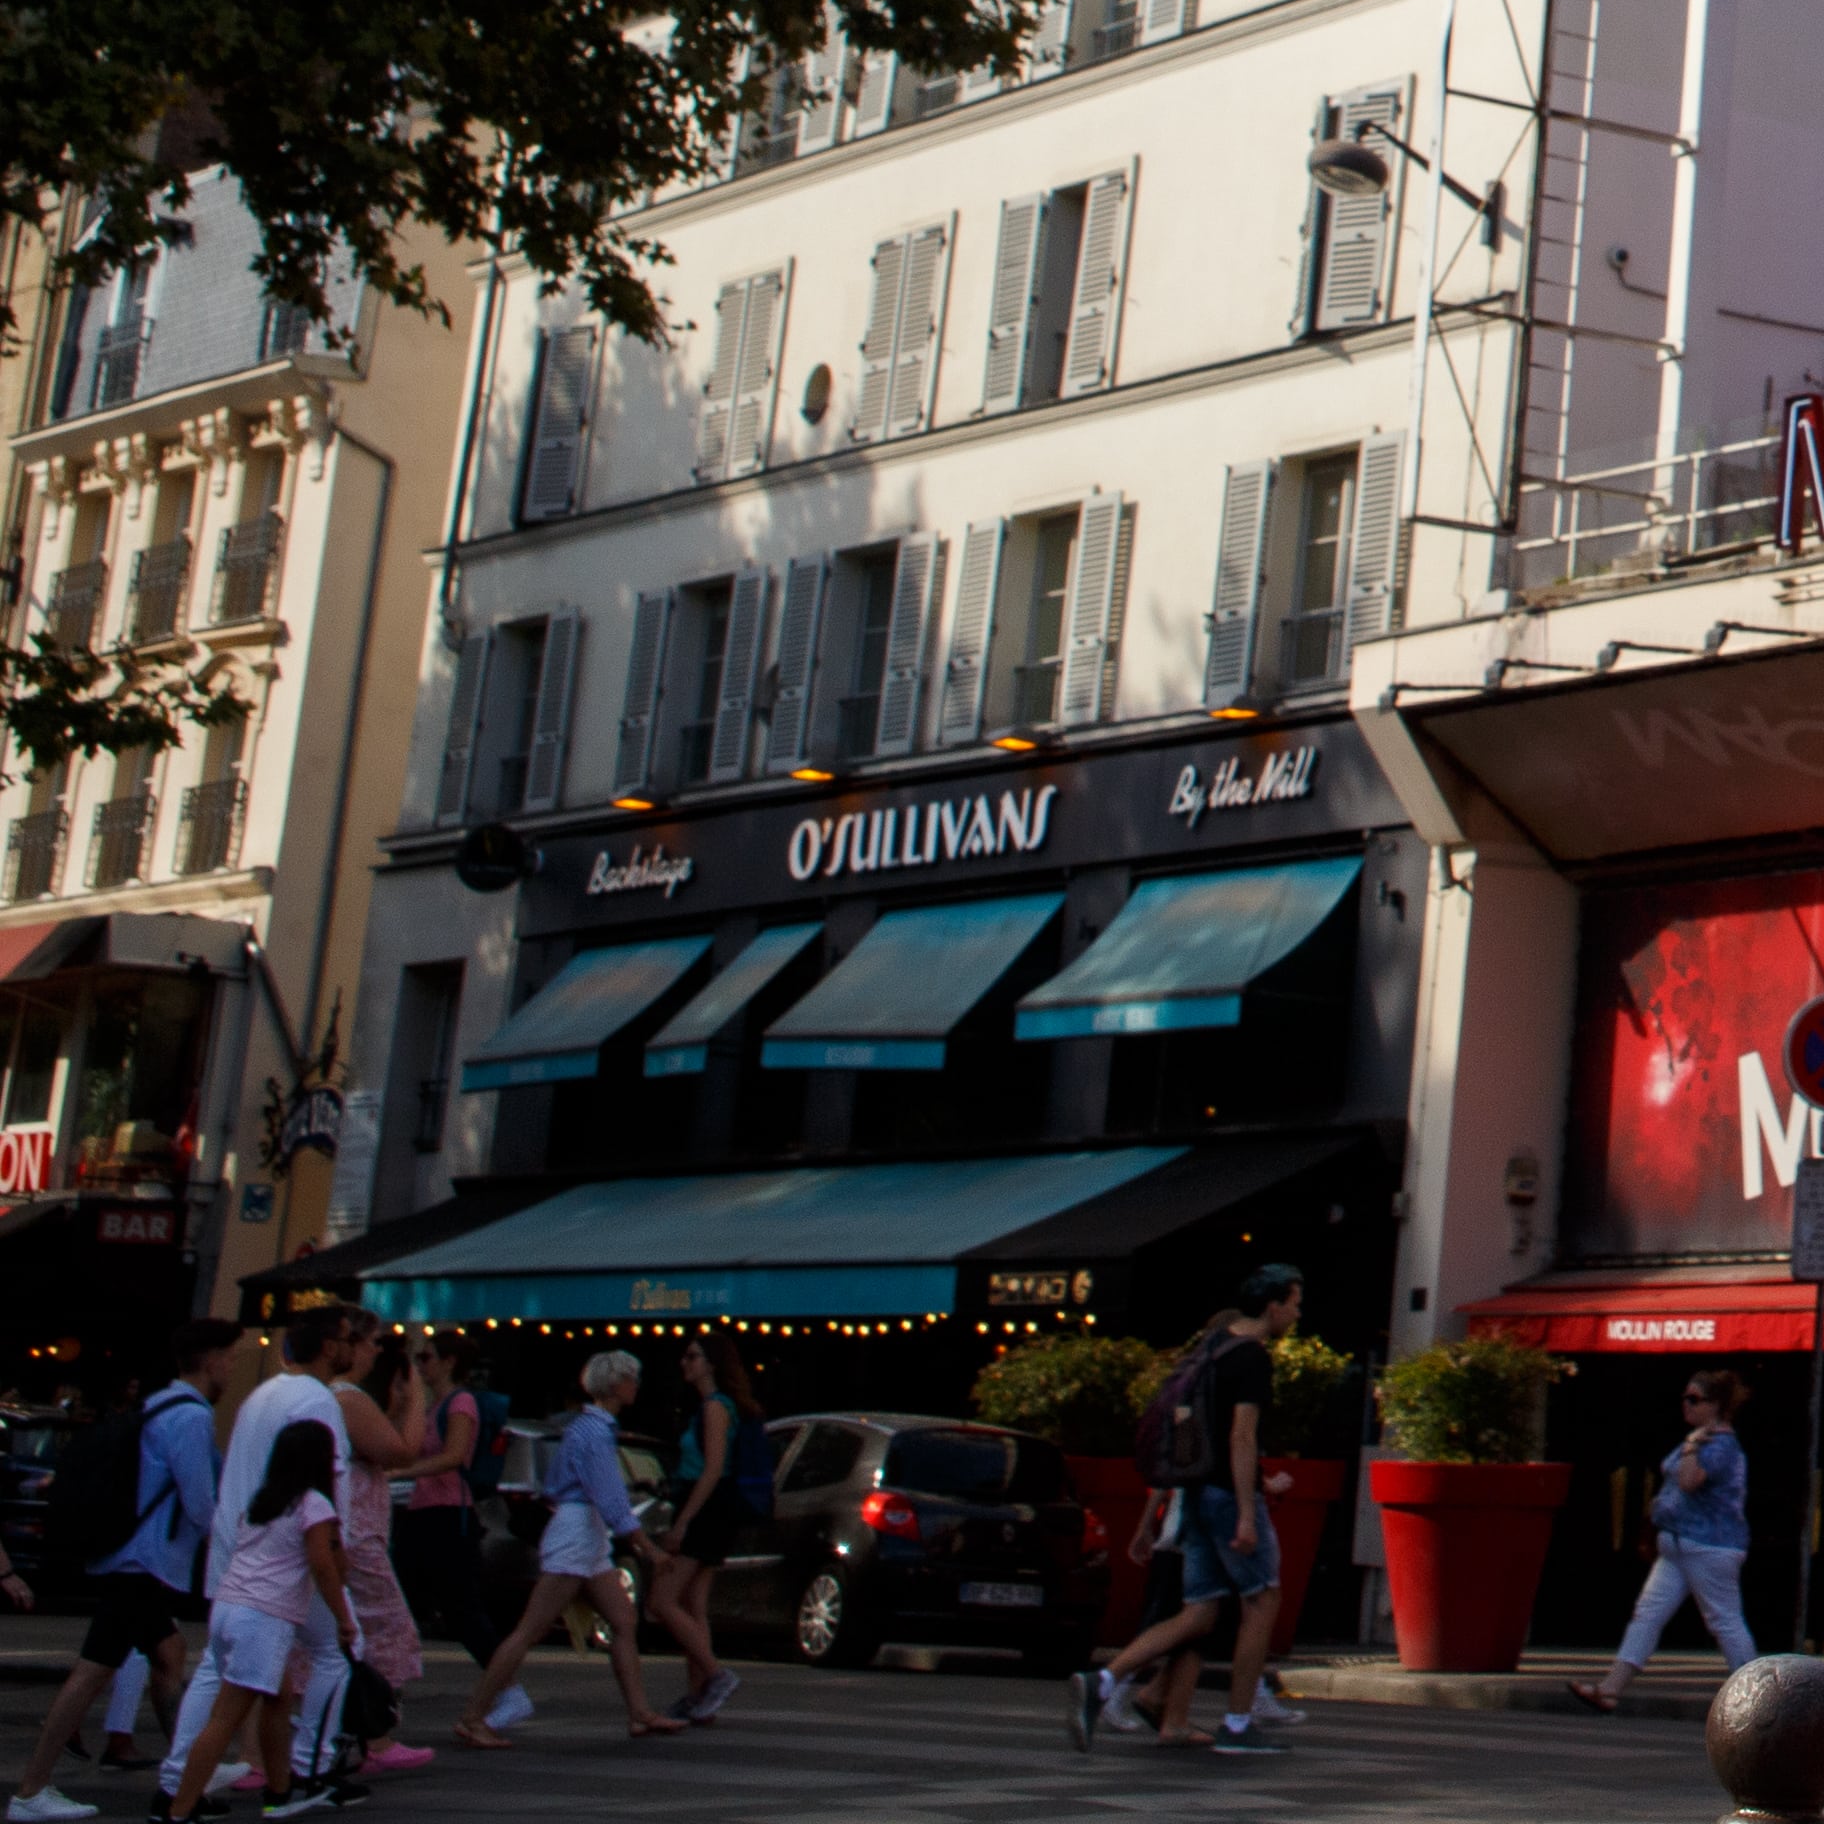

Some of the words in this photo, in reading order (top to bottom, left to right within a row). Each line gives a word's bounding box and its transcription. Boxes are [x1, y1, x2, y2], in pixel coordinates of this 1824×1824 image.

[1168, 764, 1205, 829] By
[1208, 755, 1253, 809] the
[1251, 745, 1316, 804] Mill
[788, 785, 1057, 880] O'SULLIVANS
[586, 843, 693, 899] Backstage
[101, 1211, 171, 1241] BAR
[1607, 1319, 1662, 1341] MOULIN
[1663, 1319, 1716, 1341] ROUGE
